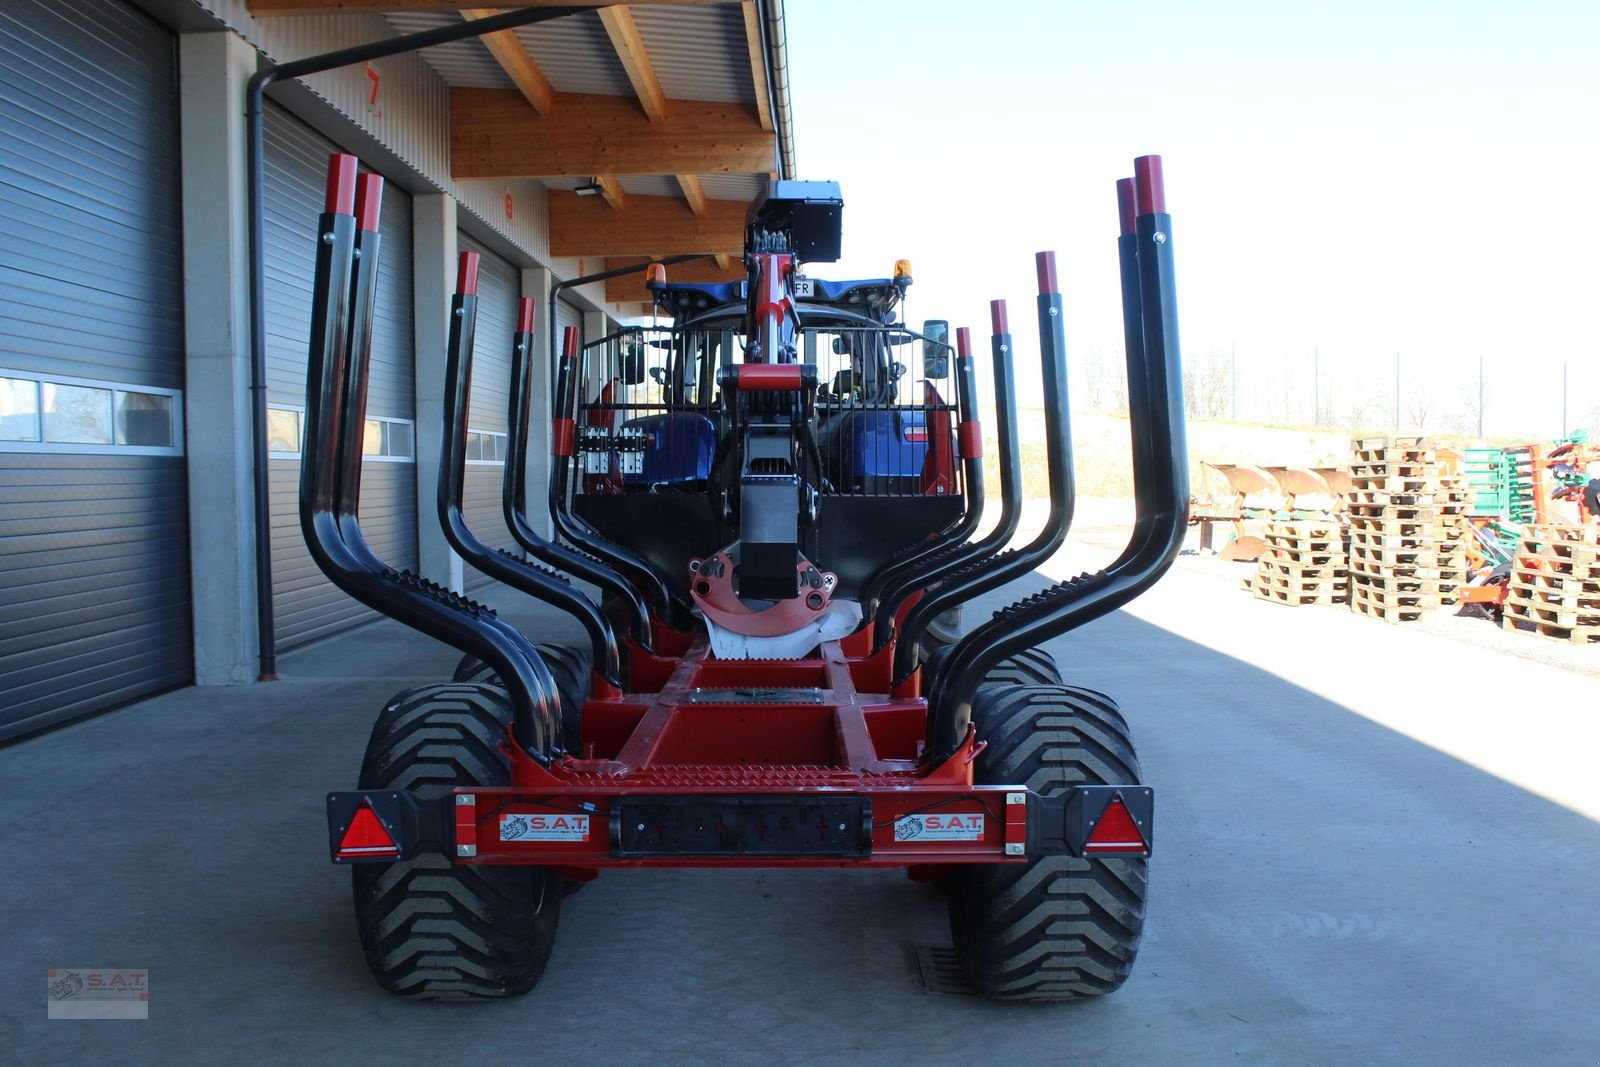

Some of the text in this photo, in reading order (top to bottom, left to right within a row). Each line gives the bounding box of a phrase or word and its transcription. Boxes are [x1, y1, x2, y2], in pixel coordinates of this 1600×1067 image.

[795, 283, 809, 294] FR
[530, 816, 587, 829] S.A.T.
[925, 815, 982, 829] S.A.T.
